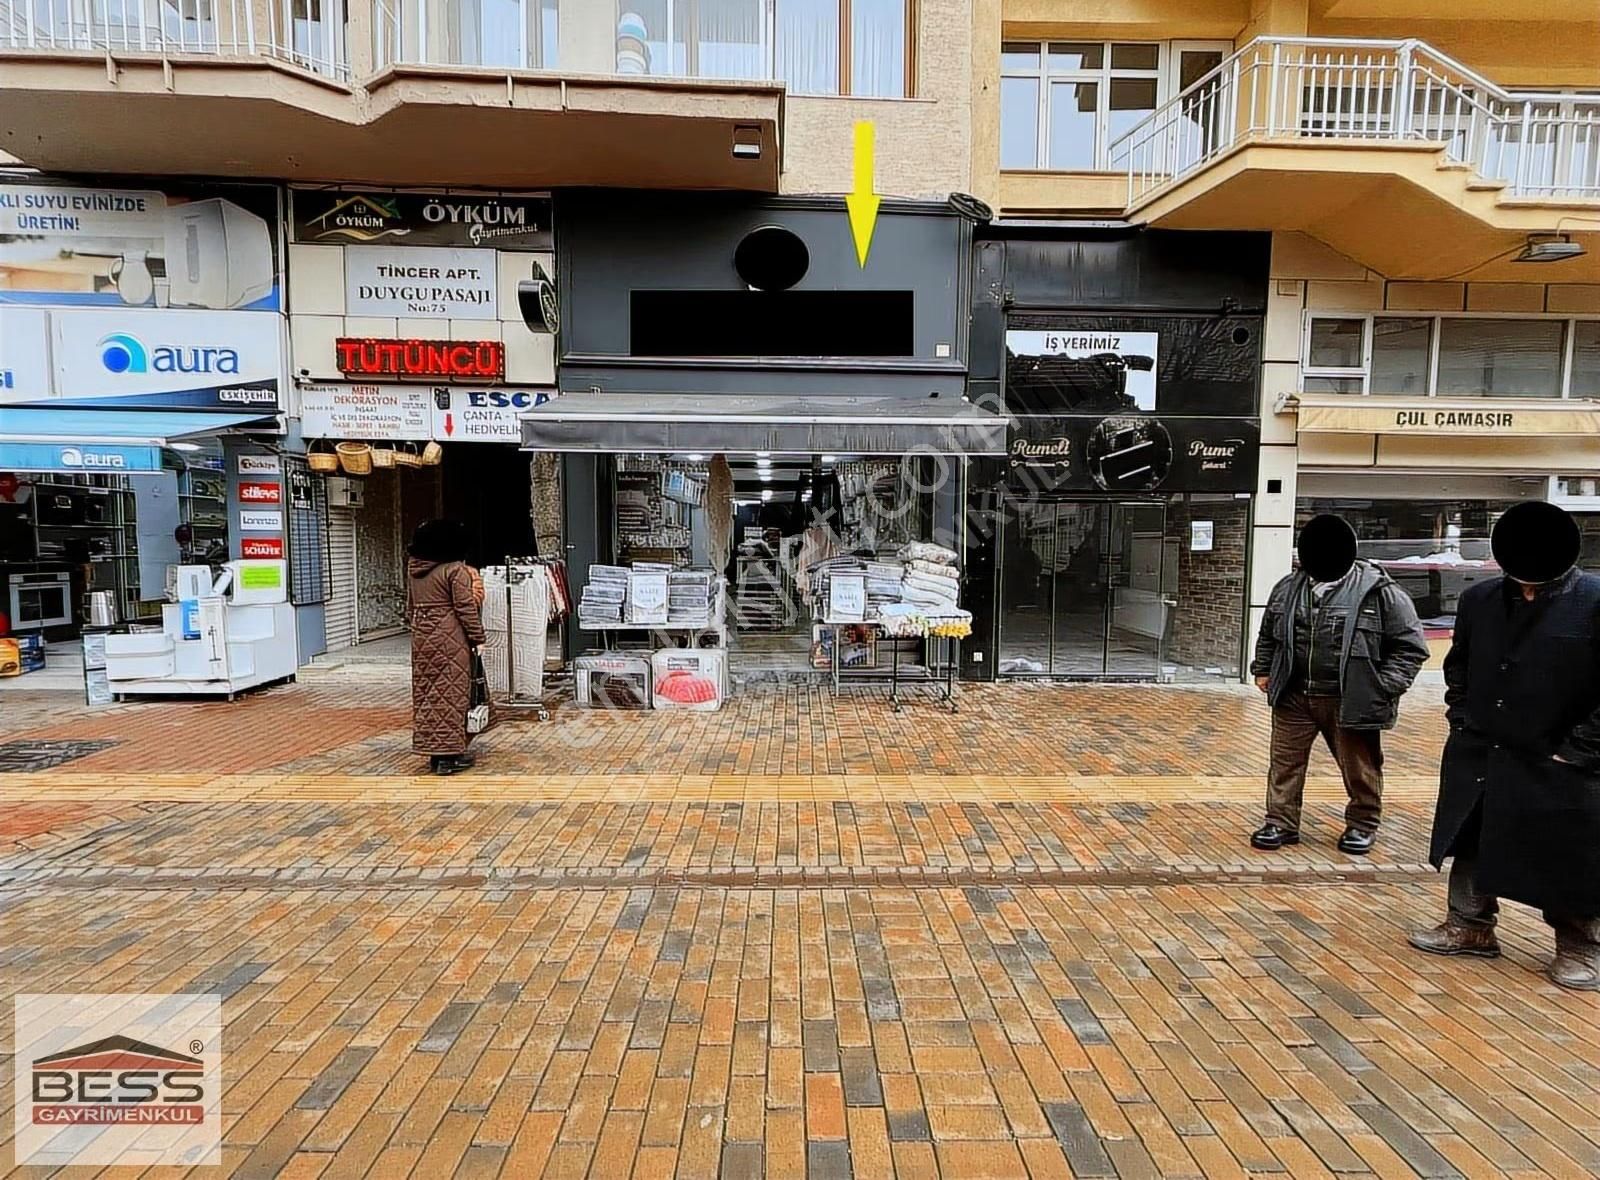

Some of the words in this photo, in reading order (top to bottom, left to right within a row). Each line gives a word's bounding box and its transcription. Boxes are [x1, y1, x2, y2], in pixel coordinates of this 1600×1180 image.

[25, 195, 67, 209] SUYU
[73, 193, 145, 212] EVİNİZDE
[423, 199, 525, 225] ÖYKÜM
[18, 213, 79, 230] ÜRETİN!
[336, 214, 383, 228] ÖYKÜM
[377, 264, 440, 279] TİNCER
[445, 269, 481, 280] APT.
[359, 286, 428, 301] DUYGU
[432, 288, 490, 305] PASAJI
[1045, 334, 1057, 350] İŞ
[1063, 334, 1120, 350] YERİMİZ
[153, 347, 239, 373] aura
[337, 339, 497, 376] TÜTÜNCÜ
[219, 388, 276, 404] ESKİŞEHİR
[334, 395, 398, 405] DEKORASYON
[463, 410, 502, 422] ÇANTA
[84, 450, 125, 467] aura
